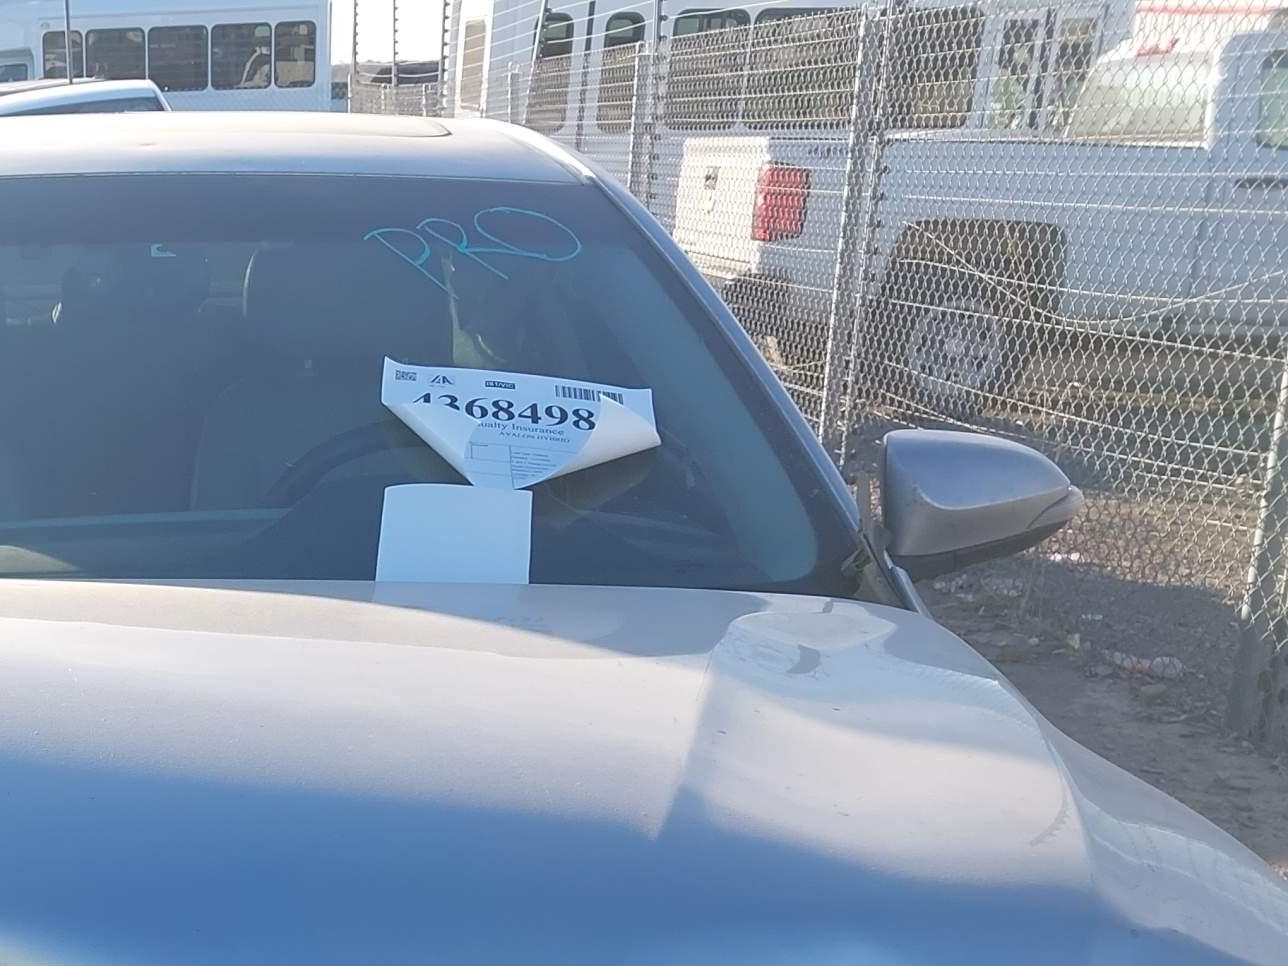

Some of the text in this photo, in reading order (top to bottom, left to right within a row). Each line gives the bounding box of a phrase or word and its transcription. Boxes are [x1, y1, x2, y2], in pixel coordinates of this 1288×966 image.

[362, 206, 583, 299] PRO
[477, 421, 565, 436] ualty Insurance
